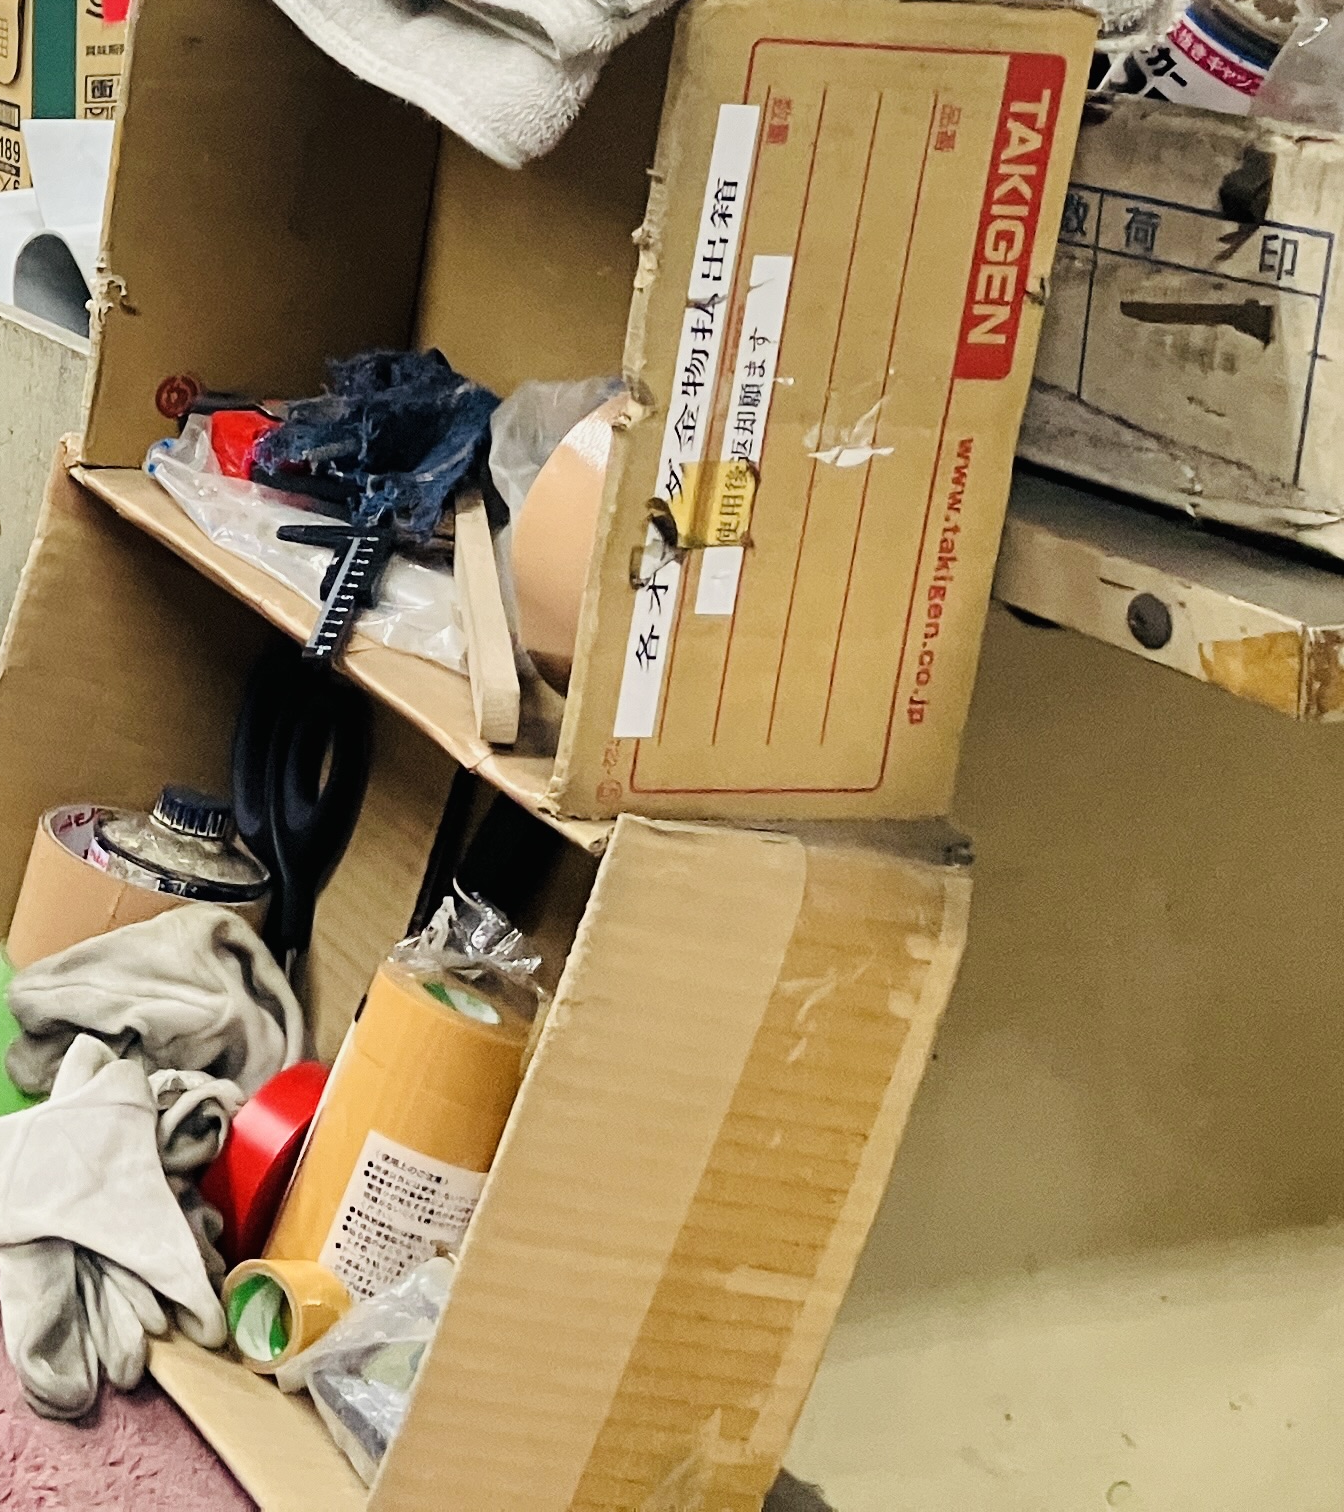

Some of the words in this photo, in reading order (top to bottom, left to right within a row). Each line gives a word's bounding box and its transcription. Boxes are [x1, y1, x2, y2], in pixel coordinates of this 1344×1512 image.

[935, 104, 964, 152] 品番
[966, 89, 1054, 349] TAKIGEN
[1259, 234, 1299, 280] 印
[634, 178, 739, 673] 各オダ金物払出箱
[715, 326, 779, 547] 使用後返却願ます
[907, 436, 975, 727] www.takigen.co.jp
